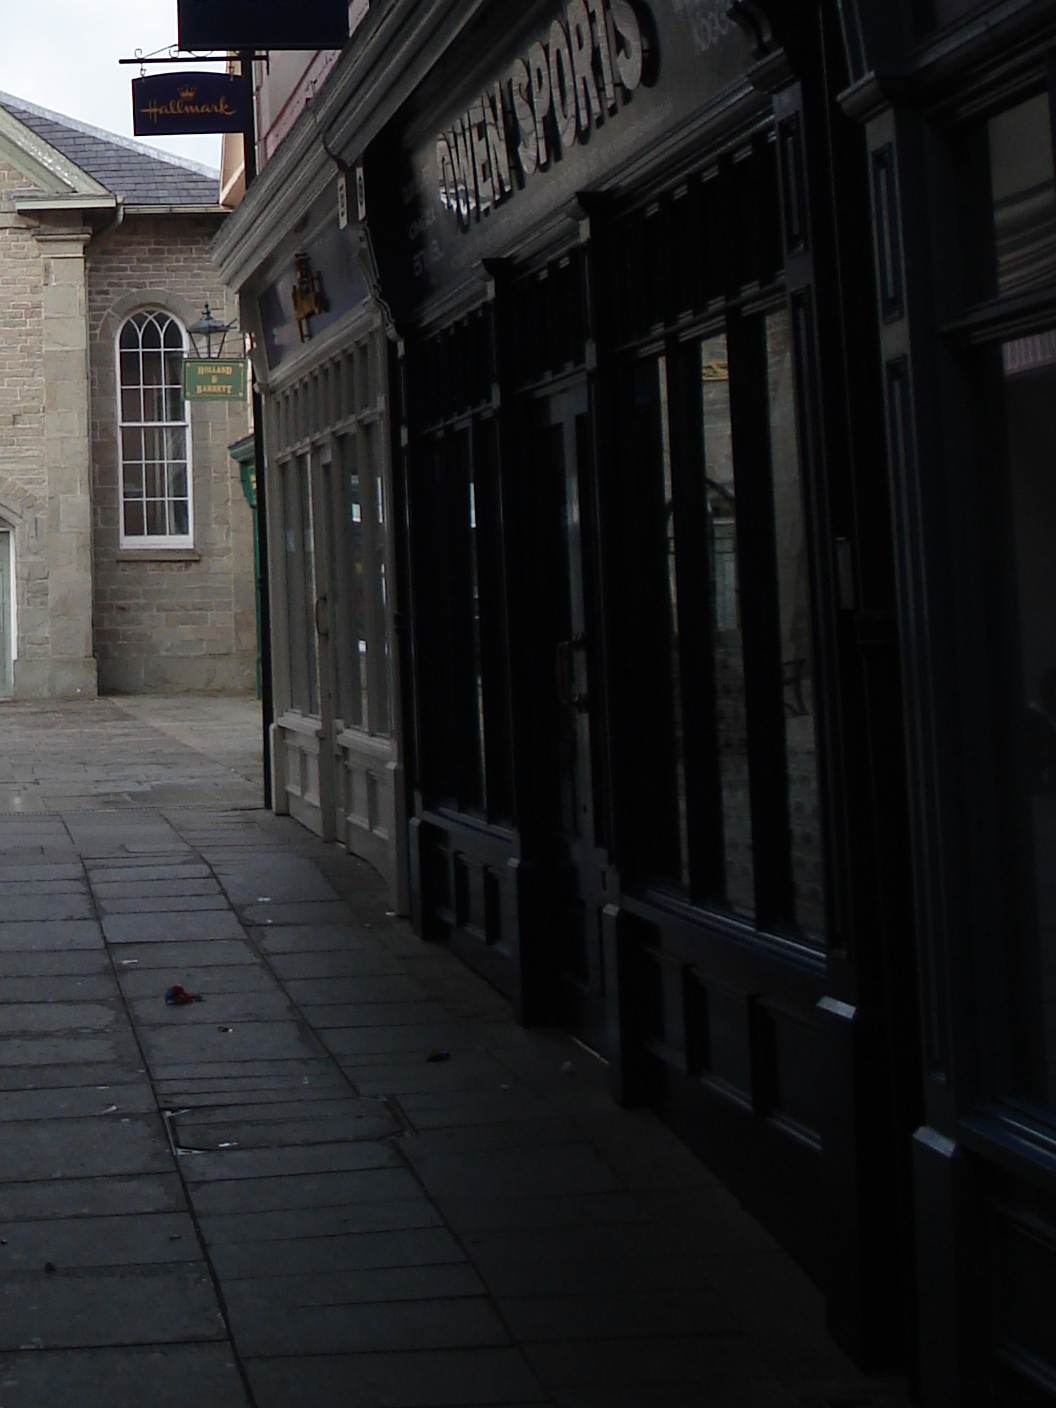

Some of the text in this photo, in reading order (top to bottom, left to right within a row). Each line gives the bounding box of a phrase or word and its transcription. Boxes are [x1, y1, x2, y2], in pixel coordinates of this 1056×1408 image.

[140, 97, 236, 124] Hallmark
[436, 79, 513, 218] OWEN
[198, 366, 233, 376] HOLLAND
[196, 385, 233, 394] BARRETT
